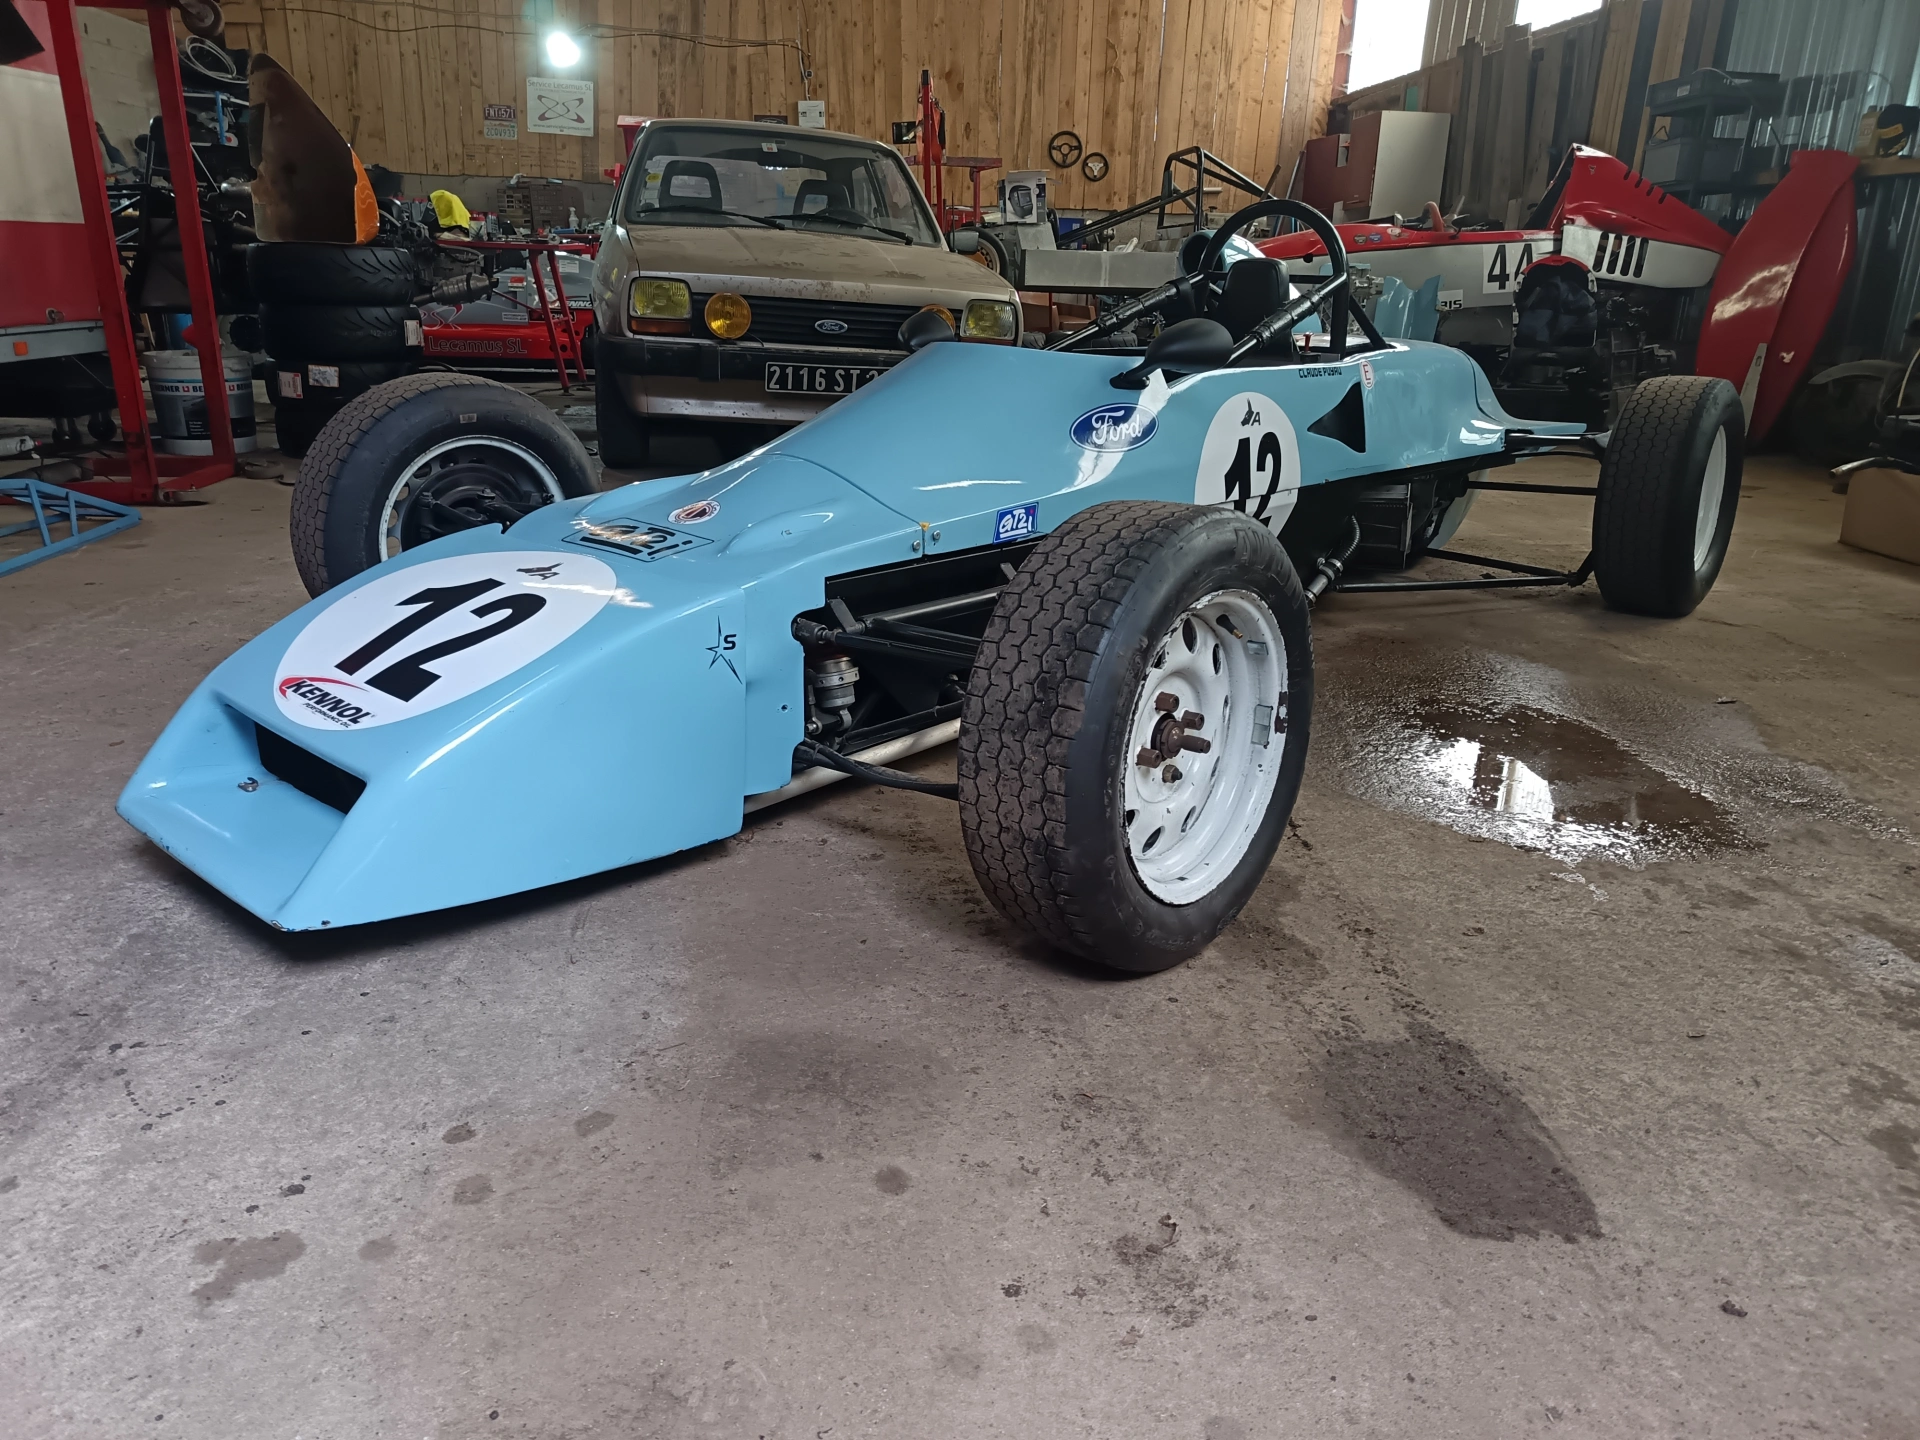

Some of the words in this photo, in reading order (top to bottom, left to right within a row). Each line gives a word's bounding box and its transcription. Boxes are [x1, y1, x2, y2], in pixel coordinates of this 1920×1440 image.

[528, 79, 552, 88] Service
[553, 81, 583, 90] Lecamus
[585, 83, 592, 91] SL
[822, 321, 840, 331] Ford
[428, 336, 503, 354] Lecamus
[506, 337, 528, 354] SL
[769, 365, 826, 391] 2116
[834, 369, 860, 392] ST
[1298, 367, 1322, 378] CLAUDE
[1091, 409, 1143, 445] Ford
[1224, 431, 1282, 528] 12
[333, 577, 547, 703] 12
[722, 633, 737, 651] S
[285, 680, 371, 725] KENNOL
